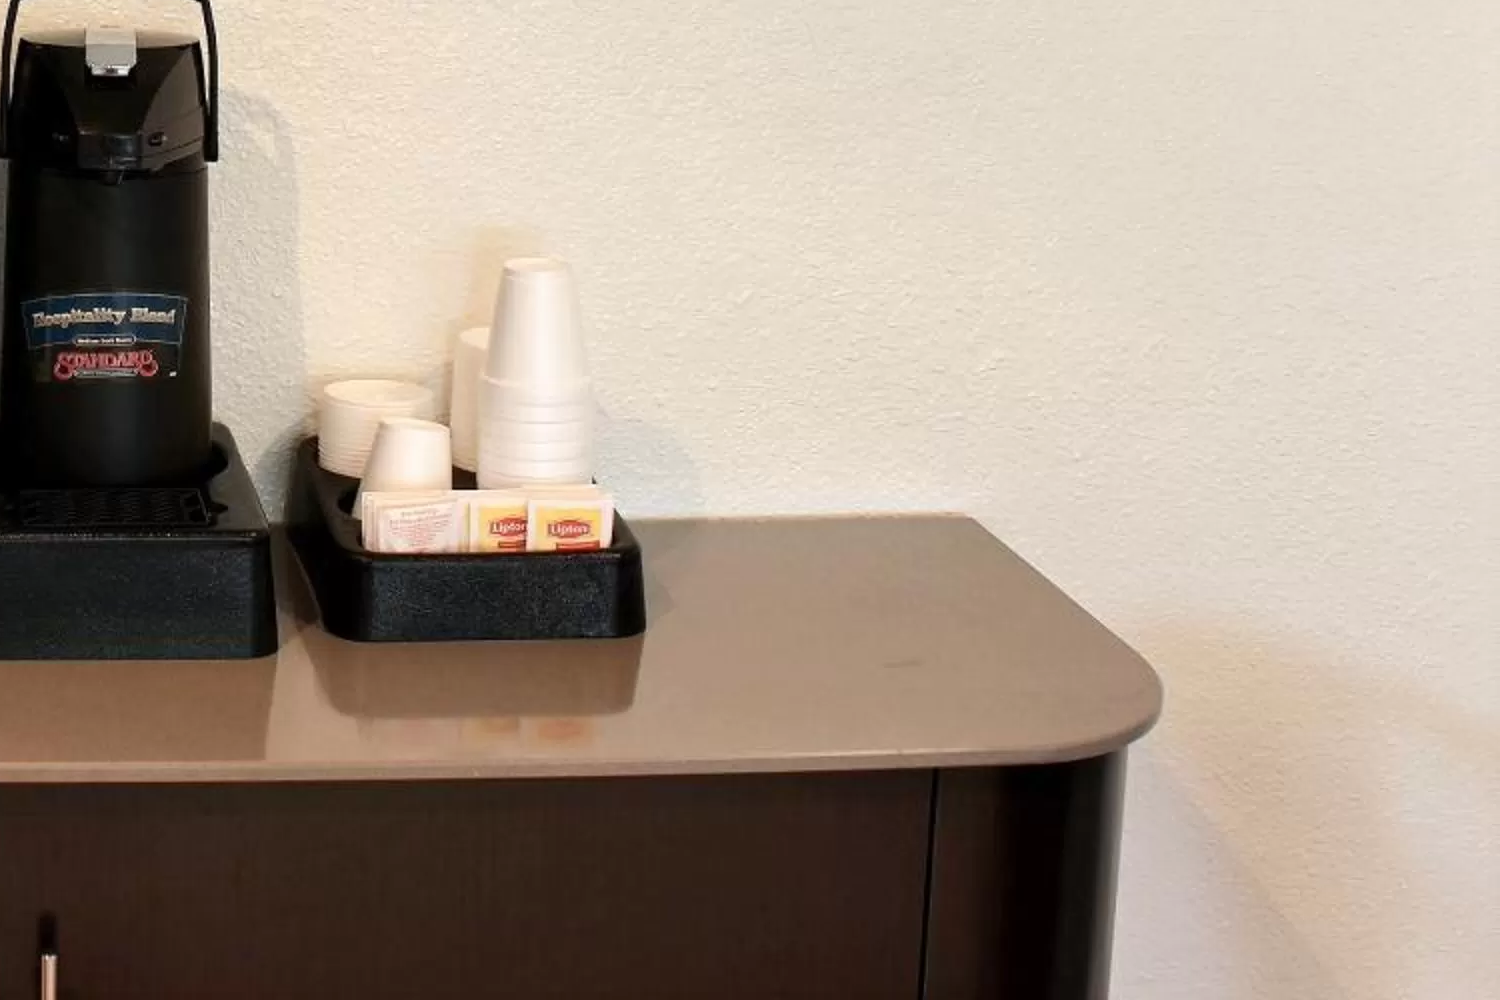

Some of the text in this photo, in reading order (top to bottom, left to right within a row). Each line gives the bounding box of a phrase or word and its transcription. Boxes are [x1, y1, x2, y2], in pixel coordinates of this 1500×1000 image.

[32, 307, 177, 329] Hospitality Blend
[550, 522, 590, 536] Lipton
